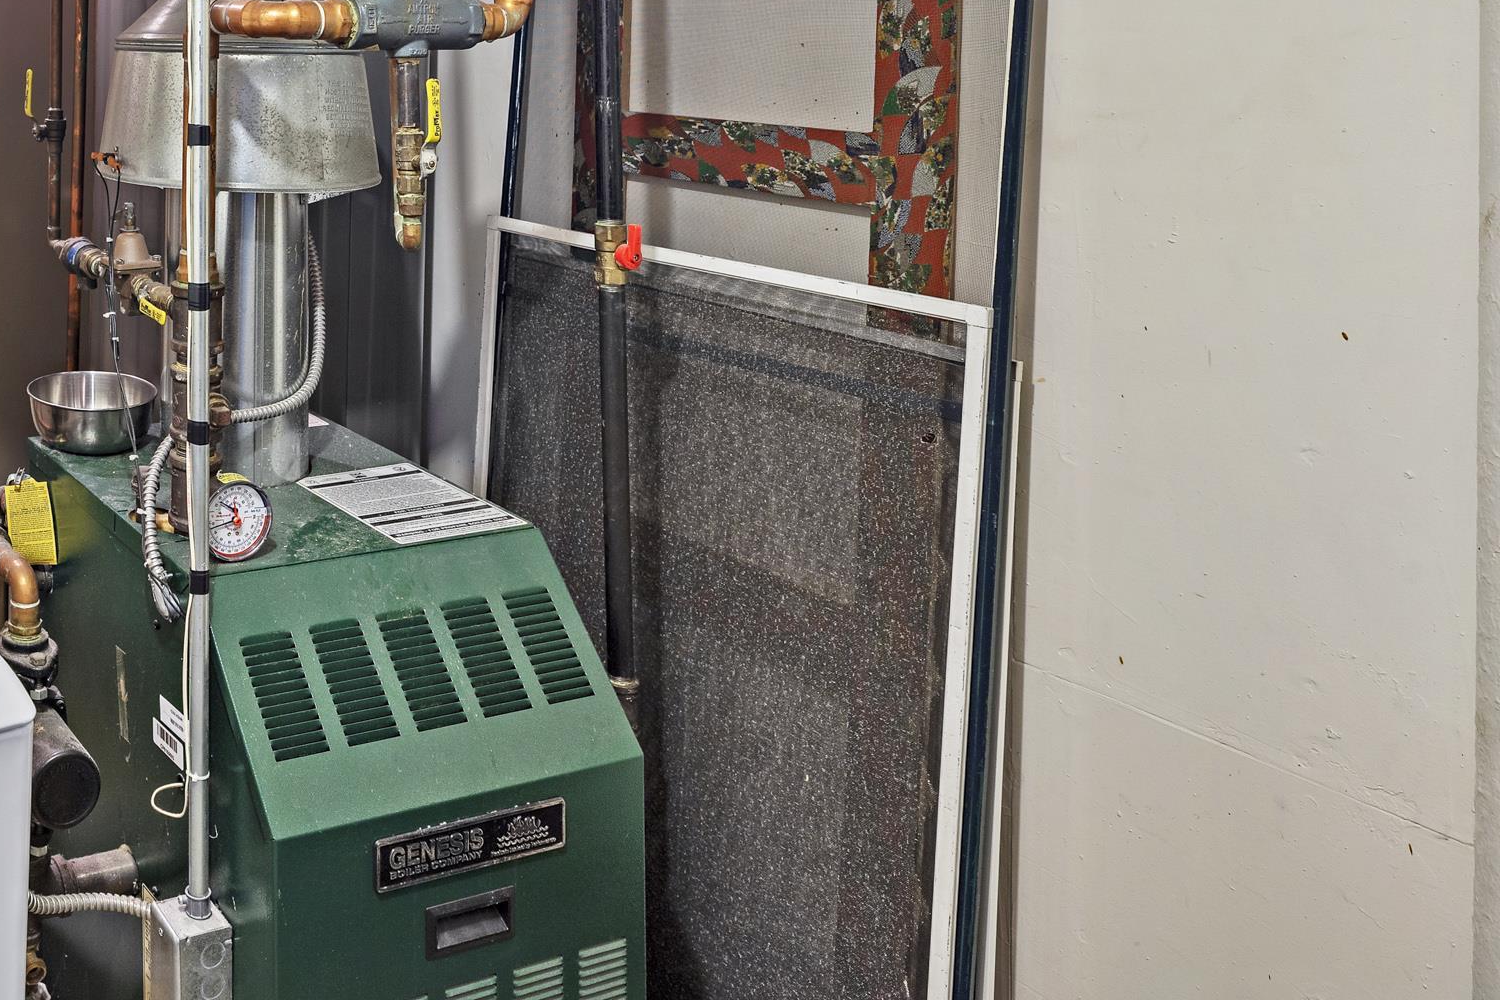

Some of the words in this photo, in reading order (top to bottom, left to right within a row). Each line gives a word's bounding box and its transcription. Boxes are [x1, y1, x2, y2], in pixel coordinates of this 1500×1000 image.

[389, 826, 484, 871] GENESIS
[389, 862, 430, 881] BOILER
[431, 849, 483, 871] COMPANY
